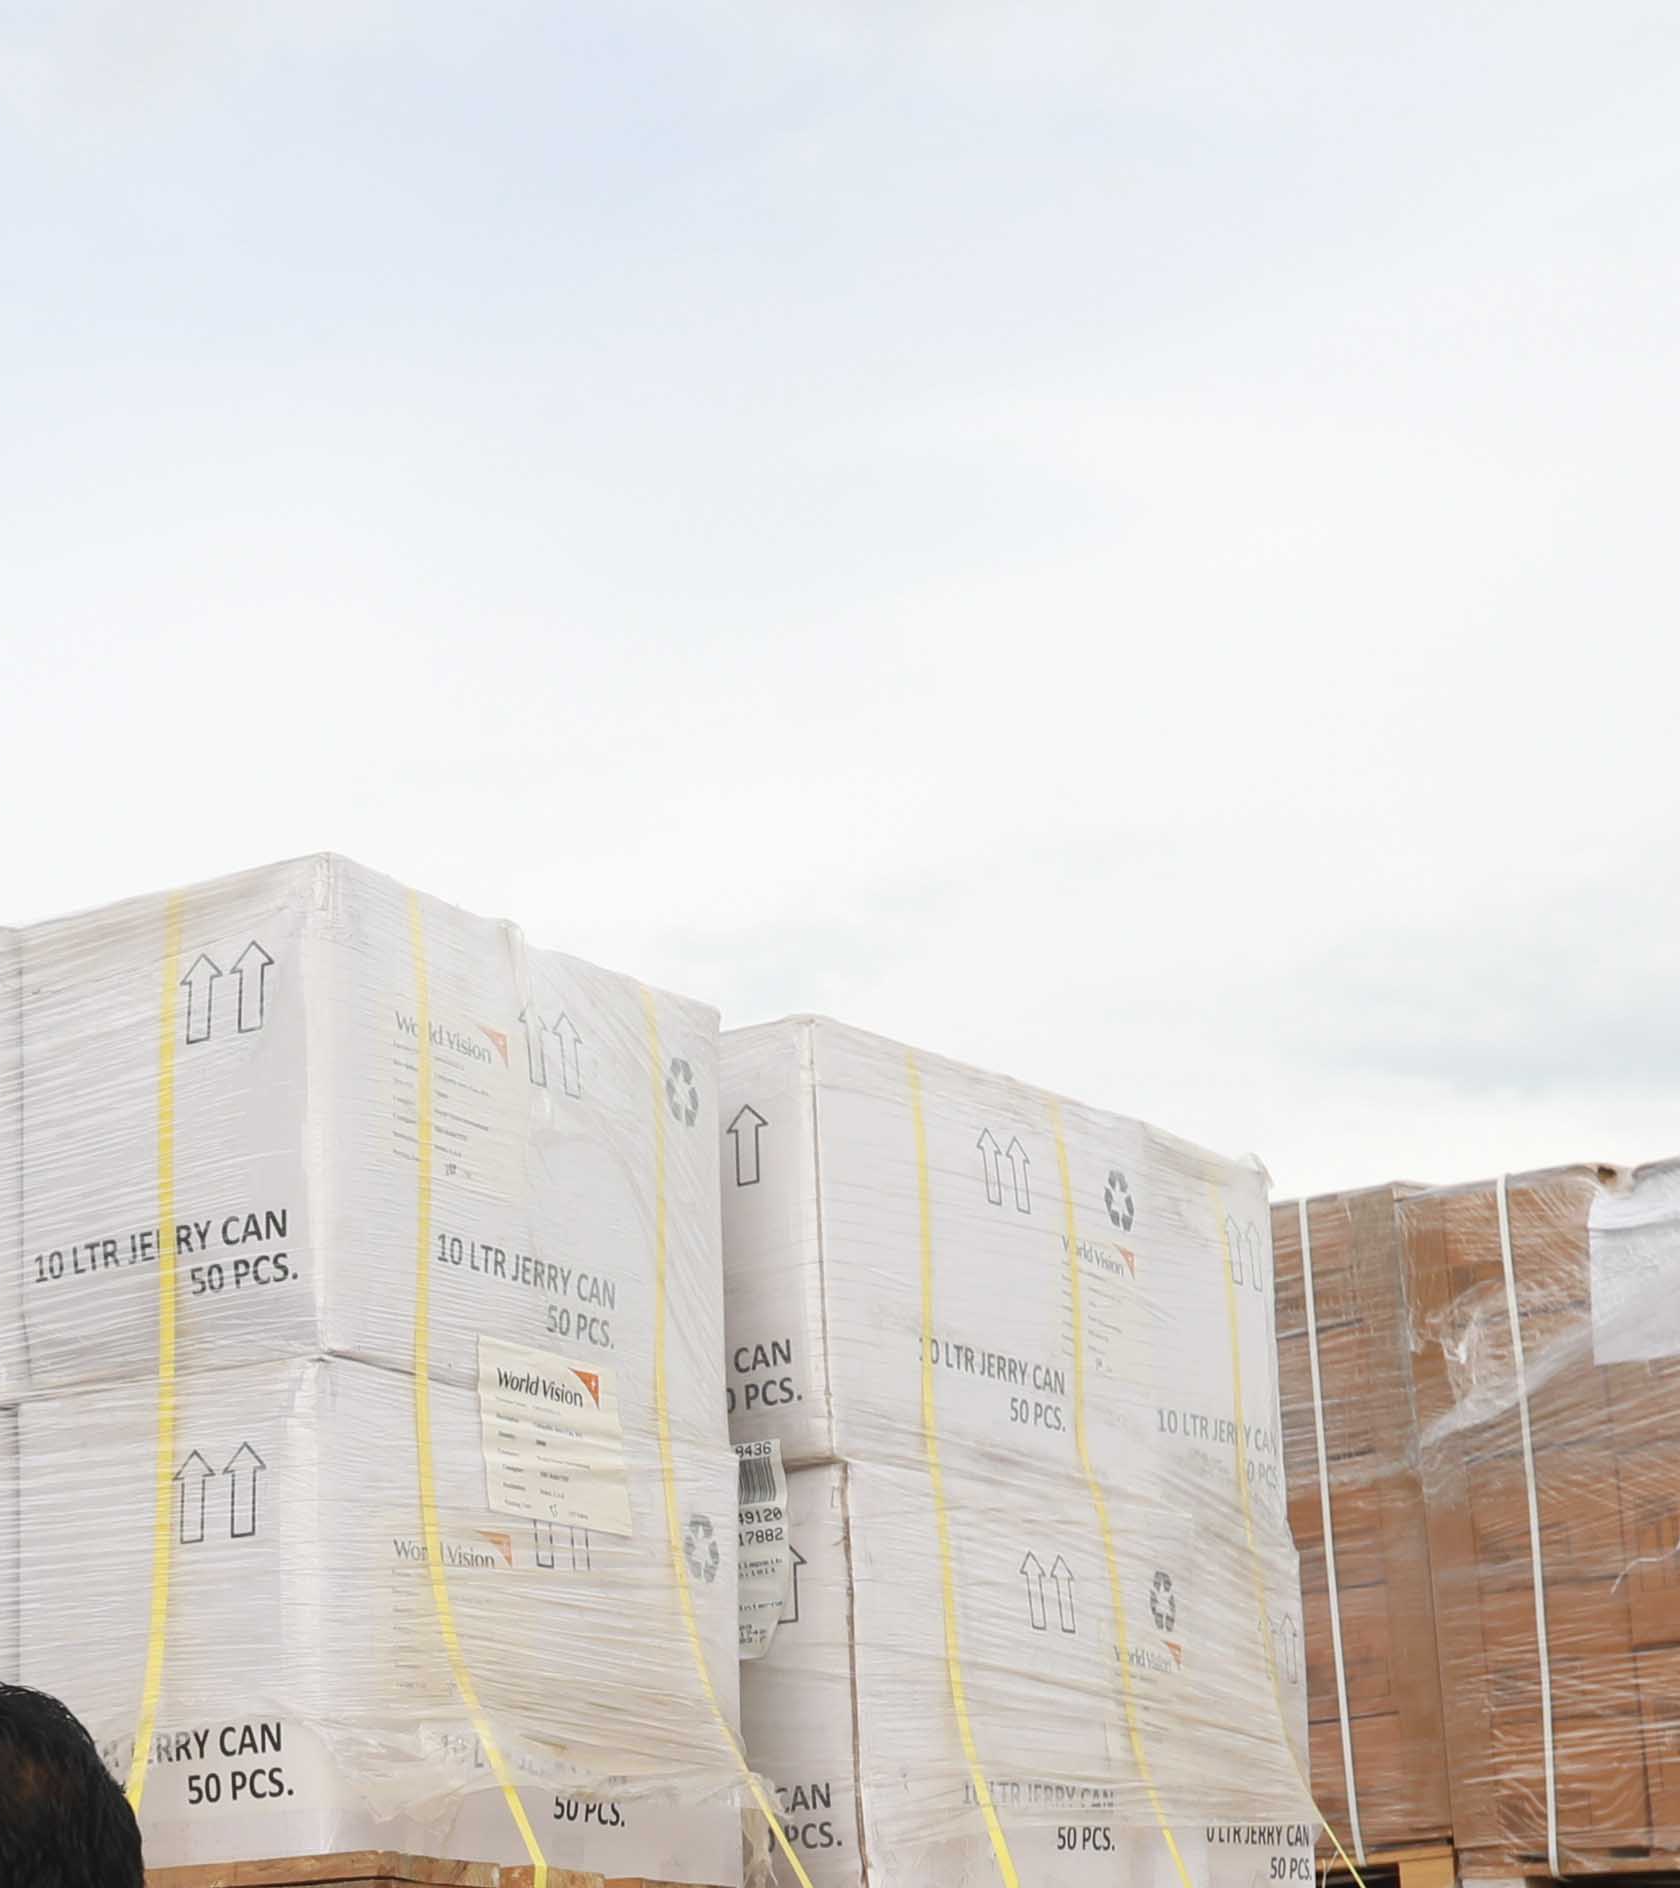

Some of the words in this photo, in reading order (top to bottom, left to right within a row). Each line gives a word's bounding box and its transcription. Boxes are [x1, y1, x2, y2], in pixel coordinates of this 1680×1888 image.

[443, 1030, 492, 1064] Vision
[34, 1251, 64, 1282] 10
[72, 1242, 119, 1278] LTR
[221, 1208, 288, 1246] CAN
[190, 1263, 225, 1296] 50
[233, 1251, 299, 1289] PCS.
[437, 1233, 462, 1265] 10
[470, 1244, 506, 1280] LTR
[511, 1255, 571, 1295] JERRY
[577, 1273, 616, 1309] CAN
[546, 1304, 571, 1336] 50
[577, 1318, 615, 1349] PCS.
[734, 1338, 792, 1374] CAN
[944, 1342, 974, 1372] LTR
[980, 1351, 1027, 1383] JERRY
[1032, 1364, 1065, 1395] CAN
[496, 1368, 539, 1397] World
[541, 1381, 583, 1407] Vision
[745, 1378, 802, 1409] PCS.
[1010, 1397, 1029, 1424] 50
[1034, 1404, 1066, 1432] PCS.
[1158, 1408, 1178, 1434] 10
[1182, 1413, 1209, 1439] LTR
[448, 1547, 495, 1568] Vision
[218, 1722, 282, 1756] CAN
[188, 1774, 221, 1804] 50
[231, 1767, 293, 1801] PCS.
[789, 1822, 842, 1849] PCS.
[1057, 1826, 1076, 1850] 50
[1082, 1826, 1115, 1850] PCS.
[1270, 1856, 1286, 1879] 50
[1290, 1856, 1312, 1880] PCS.
